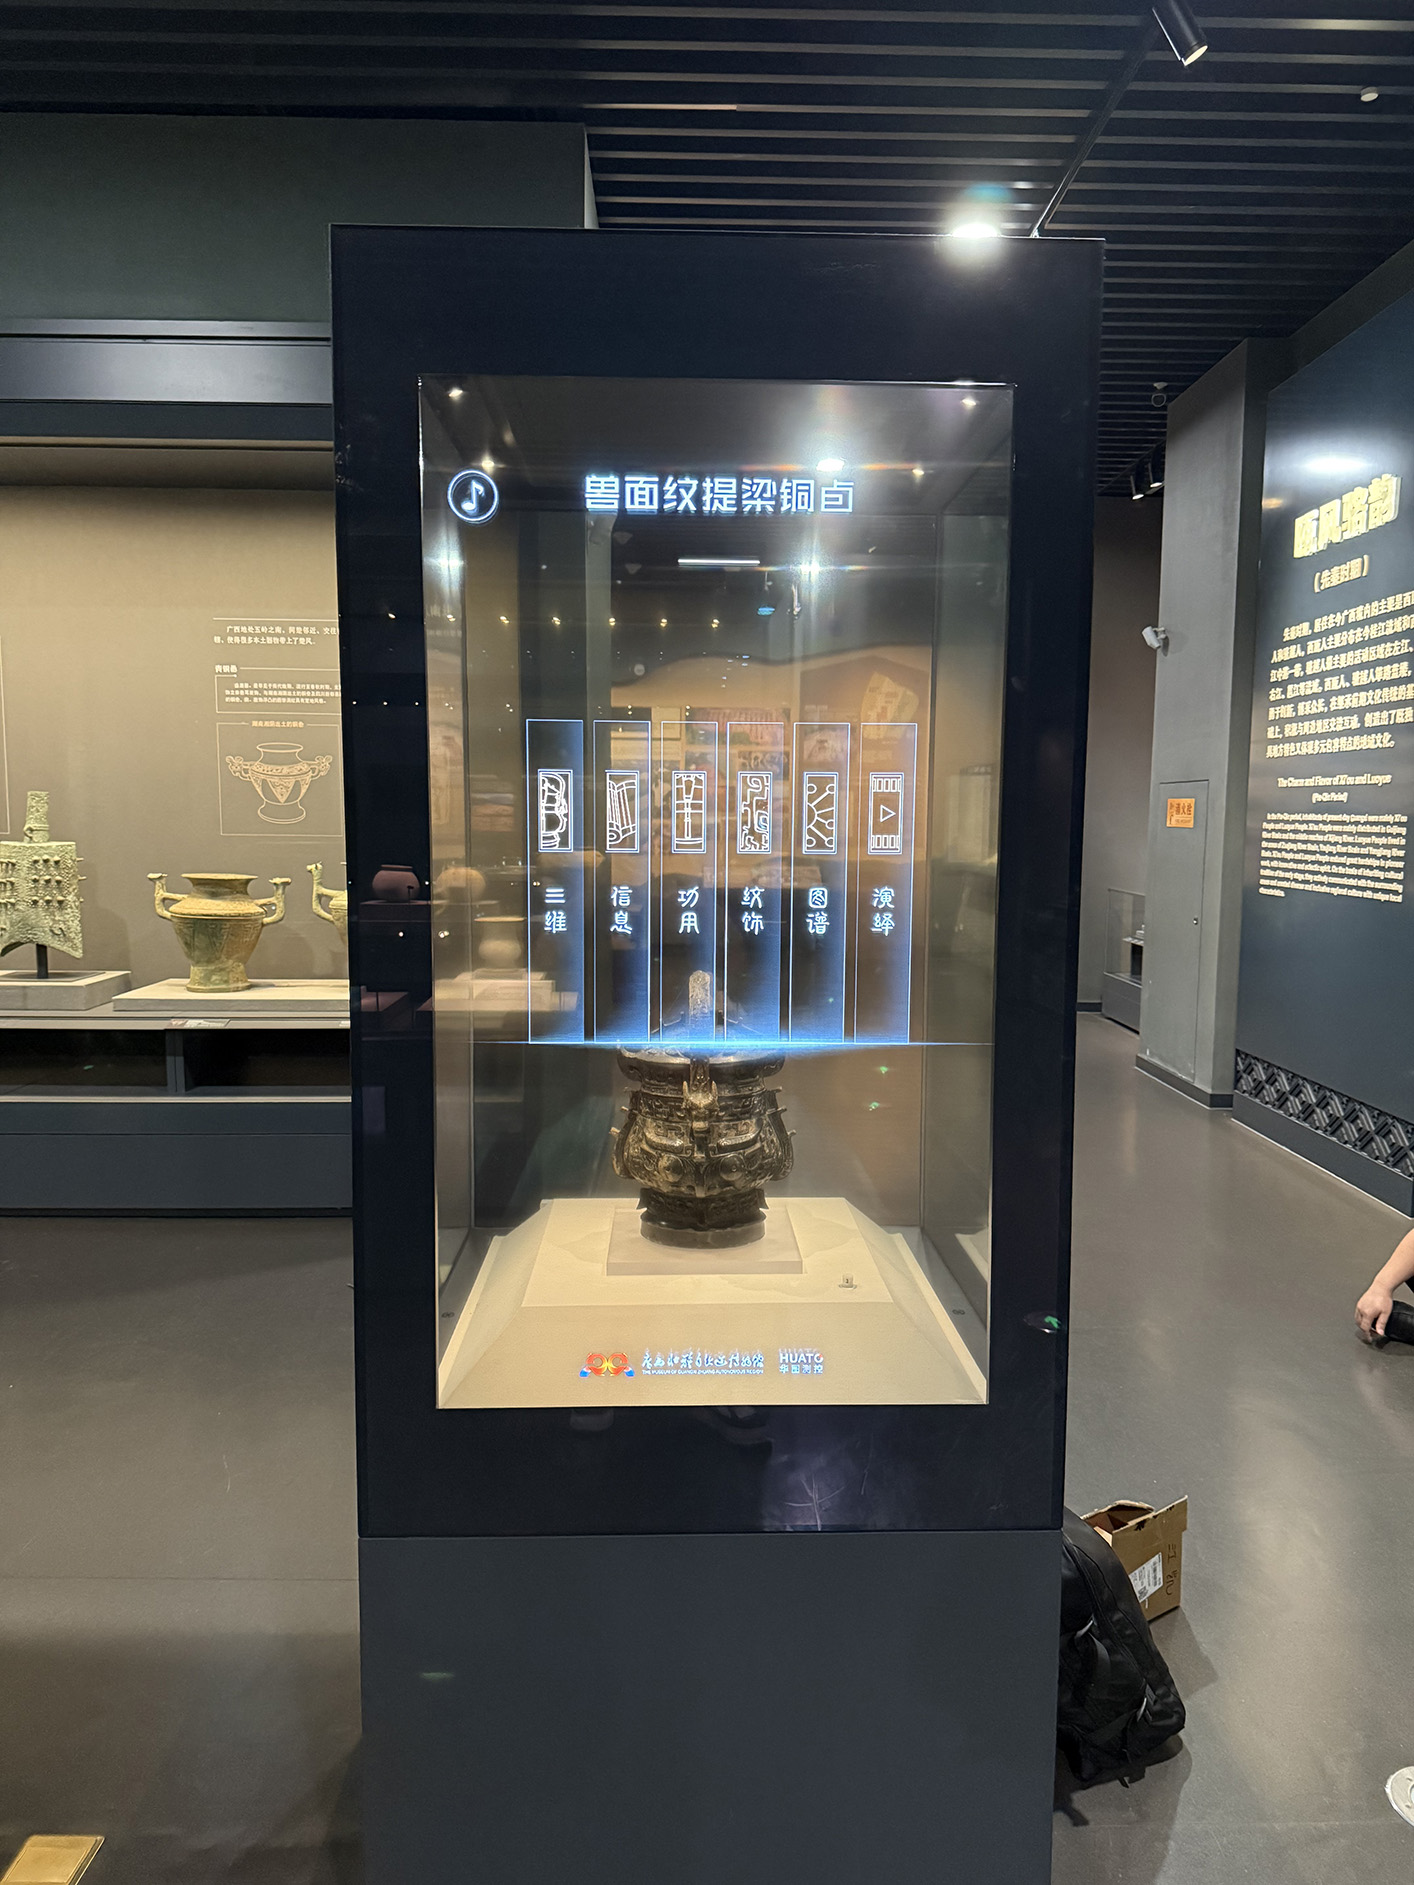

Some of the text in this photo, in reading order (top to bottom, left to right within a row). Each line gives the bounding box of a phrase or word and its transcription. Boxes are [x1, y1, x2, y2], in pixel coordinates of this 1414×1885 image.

[584, 474, 855, 514] 兽面纹提梁铜卣
[543, 886, 567, 934] 三维
[610, 886, 633, 935] 信息
[677, 886, 700, 935] 功用
[741, 886, 765, 935] 纹饰
[806, 886, 830, 935] 图谱
[871, 886, 895, 936] 演绎
